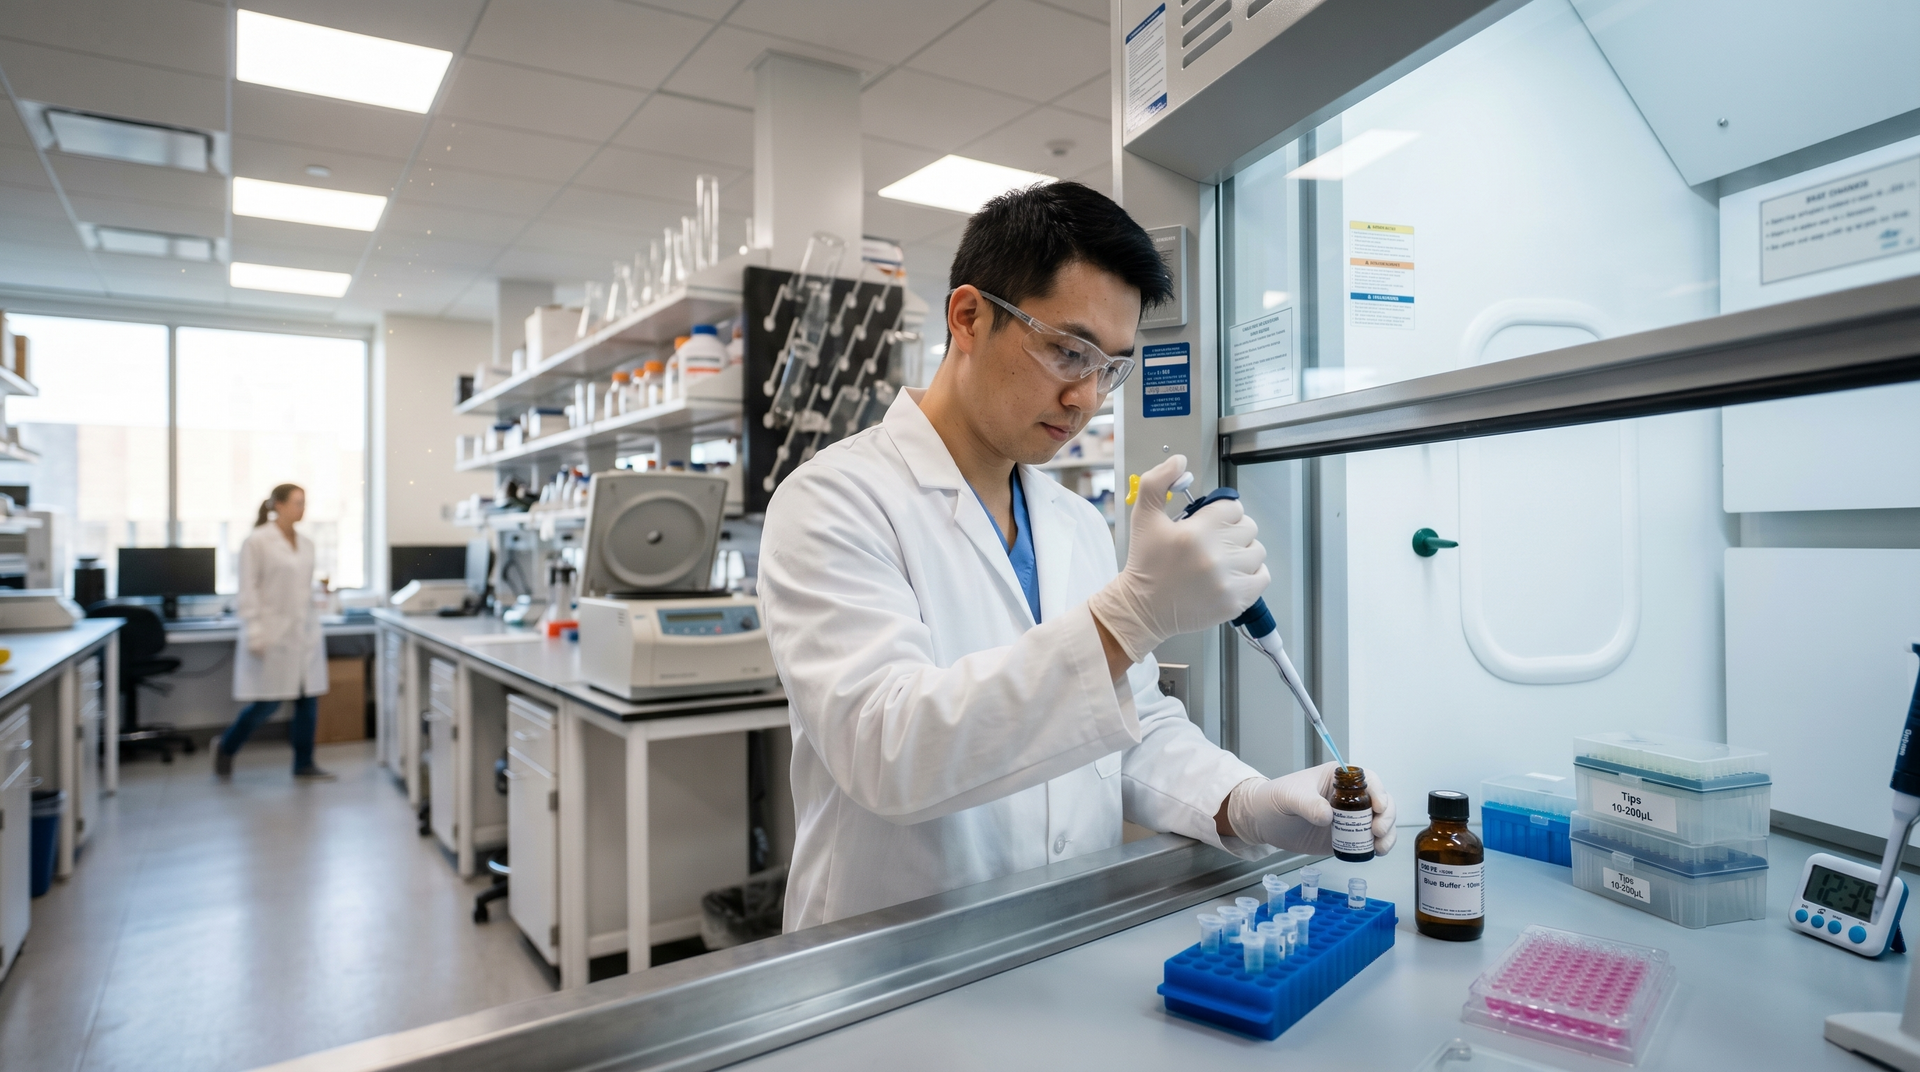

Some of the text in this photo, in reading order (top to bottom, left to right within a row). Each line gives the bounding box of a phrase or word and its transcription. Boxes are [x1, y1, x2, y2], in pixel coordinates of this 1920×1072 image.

[1621, 791, 1642, 806] Tips
[1611, 803, 1653, 821] 10-200µL
[1423, 877, 1438, 887] Blue
[1439, 881, 1461, 889] Buffer
[1611, 881, 1644, 899] 10-200µL
